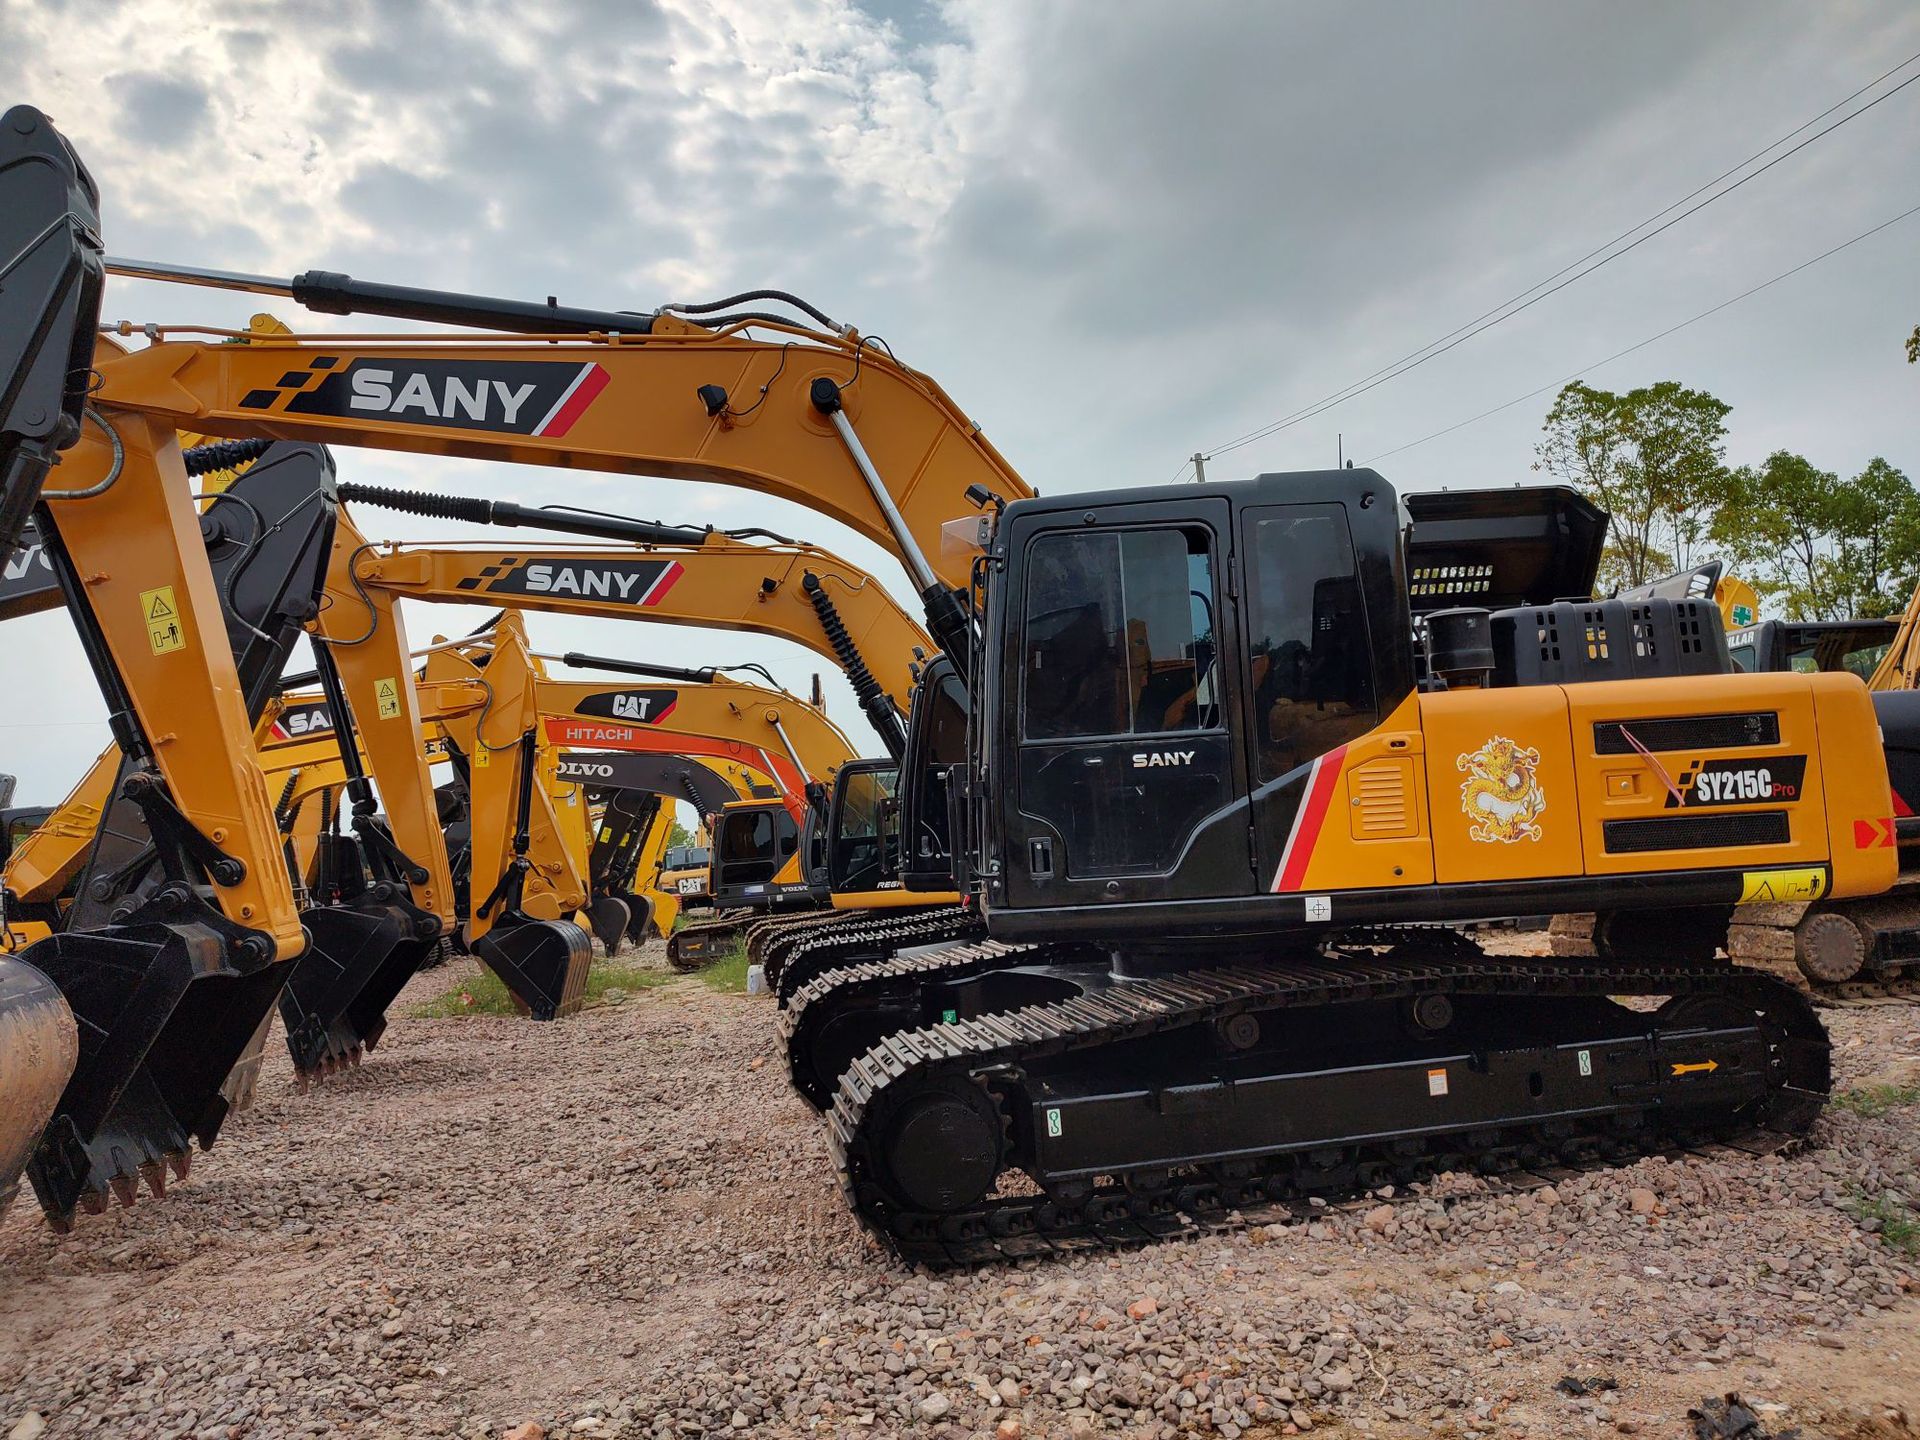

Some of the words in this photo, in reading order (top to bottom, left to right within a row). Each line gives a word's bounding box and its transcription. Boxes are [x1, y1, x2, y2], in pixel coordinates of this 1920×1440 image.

[350, 368, 537, 424] SANY
[525, 564, 640, 599] SANY
[1727, 631, 1755, 649] ILLAR
[612, 694, 651, 720] CAT
[288, 709, 333, 735] SA
[566, 727, 633, 741] HITACHI
[1132, 750, 1195, 768] SANY
